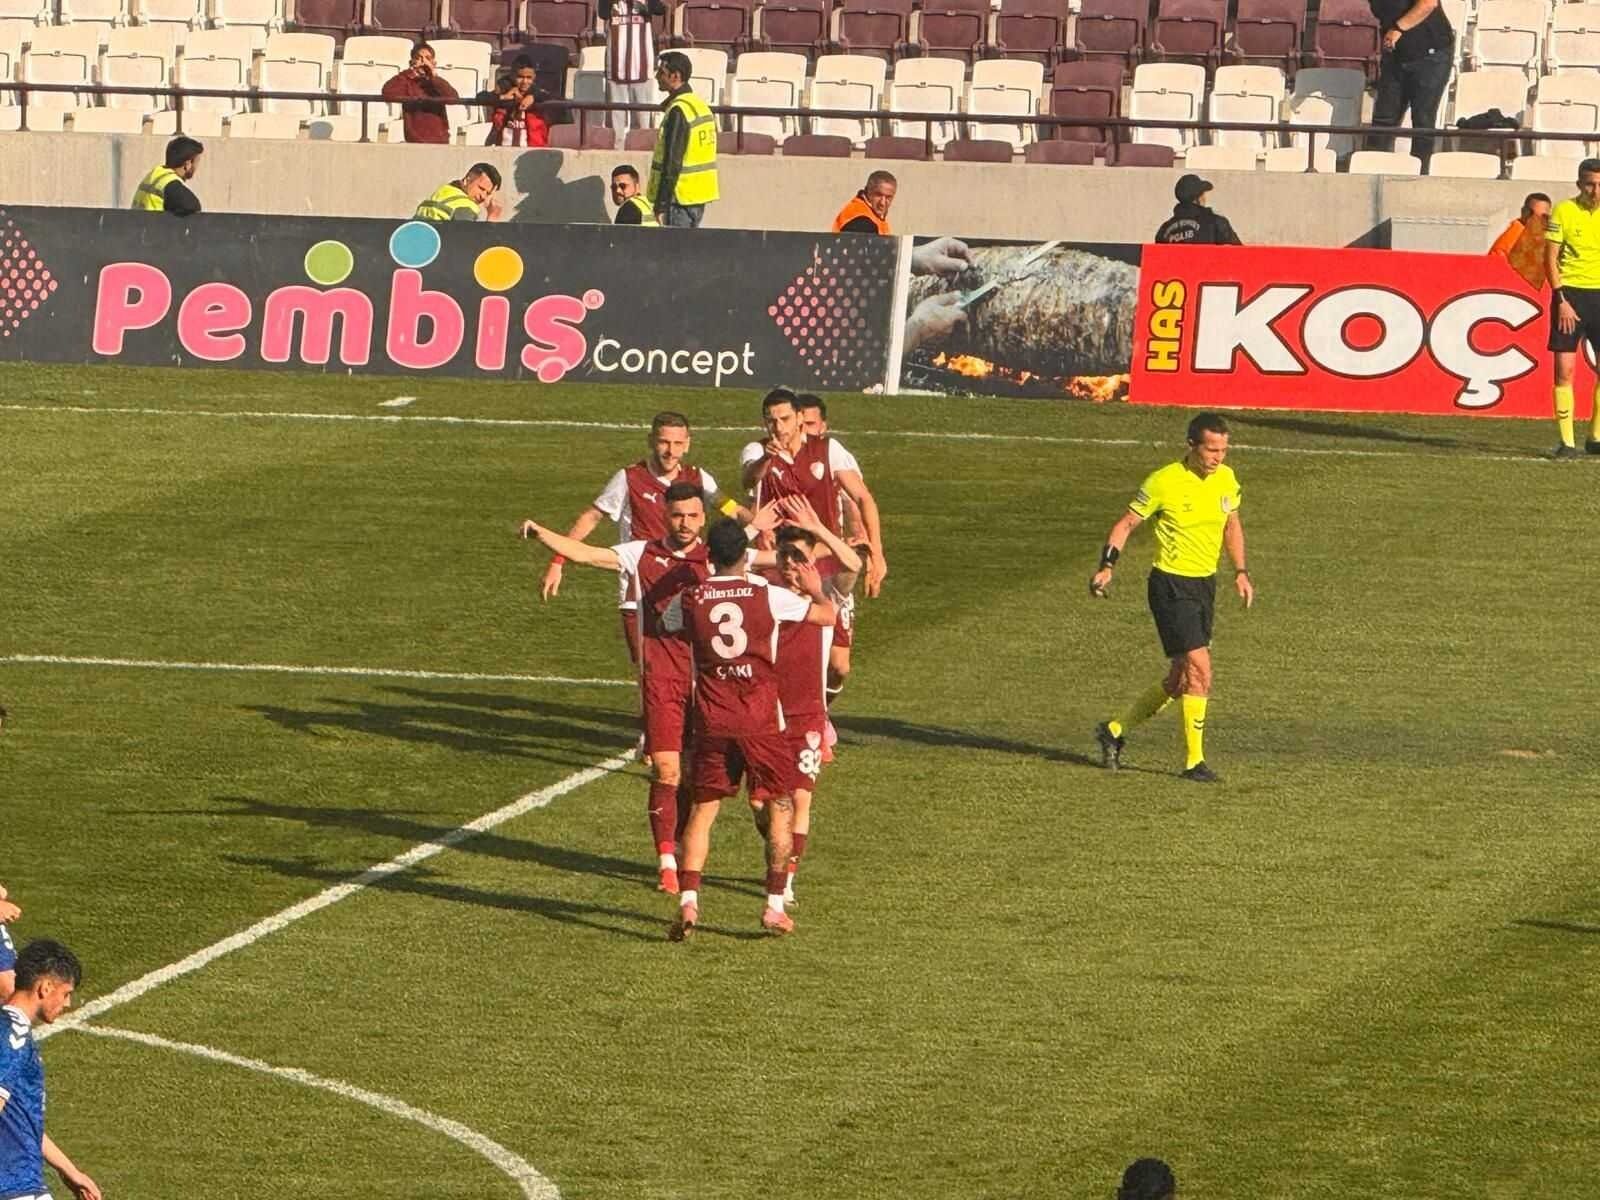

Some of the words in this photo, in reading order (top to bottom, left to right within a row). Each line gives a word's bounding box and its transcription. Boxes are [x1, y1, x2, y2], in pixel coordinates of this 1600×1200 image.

[92, 246, 588, 383] Pembiş
[1146, 279, 1187, 372] HAS
[1192, 282, 1543, 409] KOÇ
[593, 338, 755, 388] Concept
[709, 601, 748, 659] 3
[716, 664, 753, 680] ÇAKI
